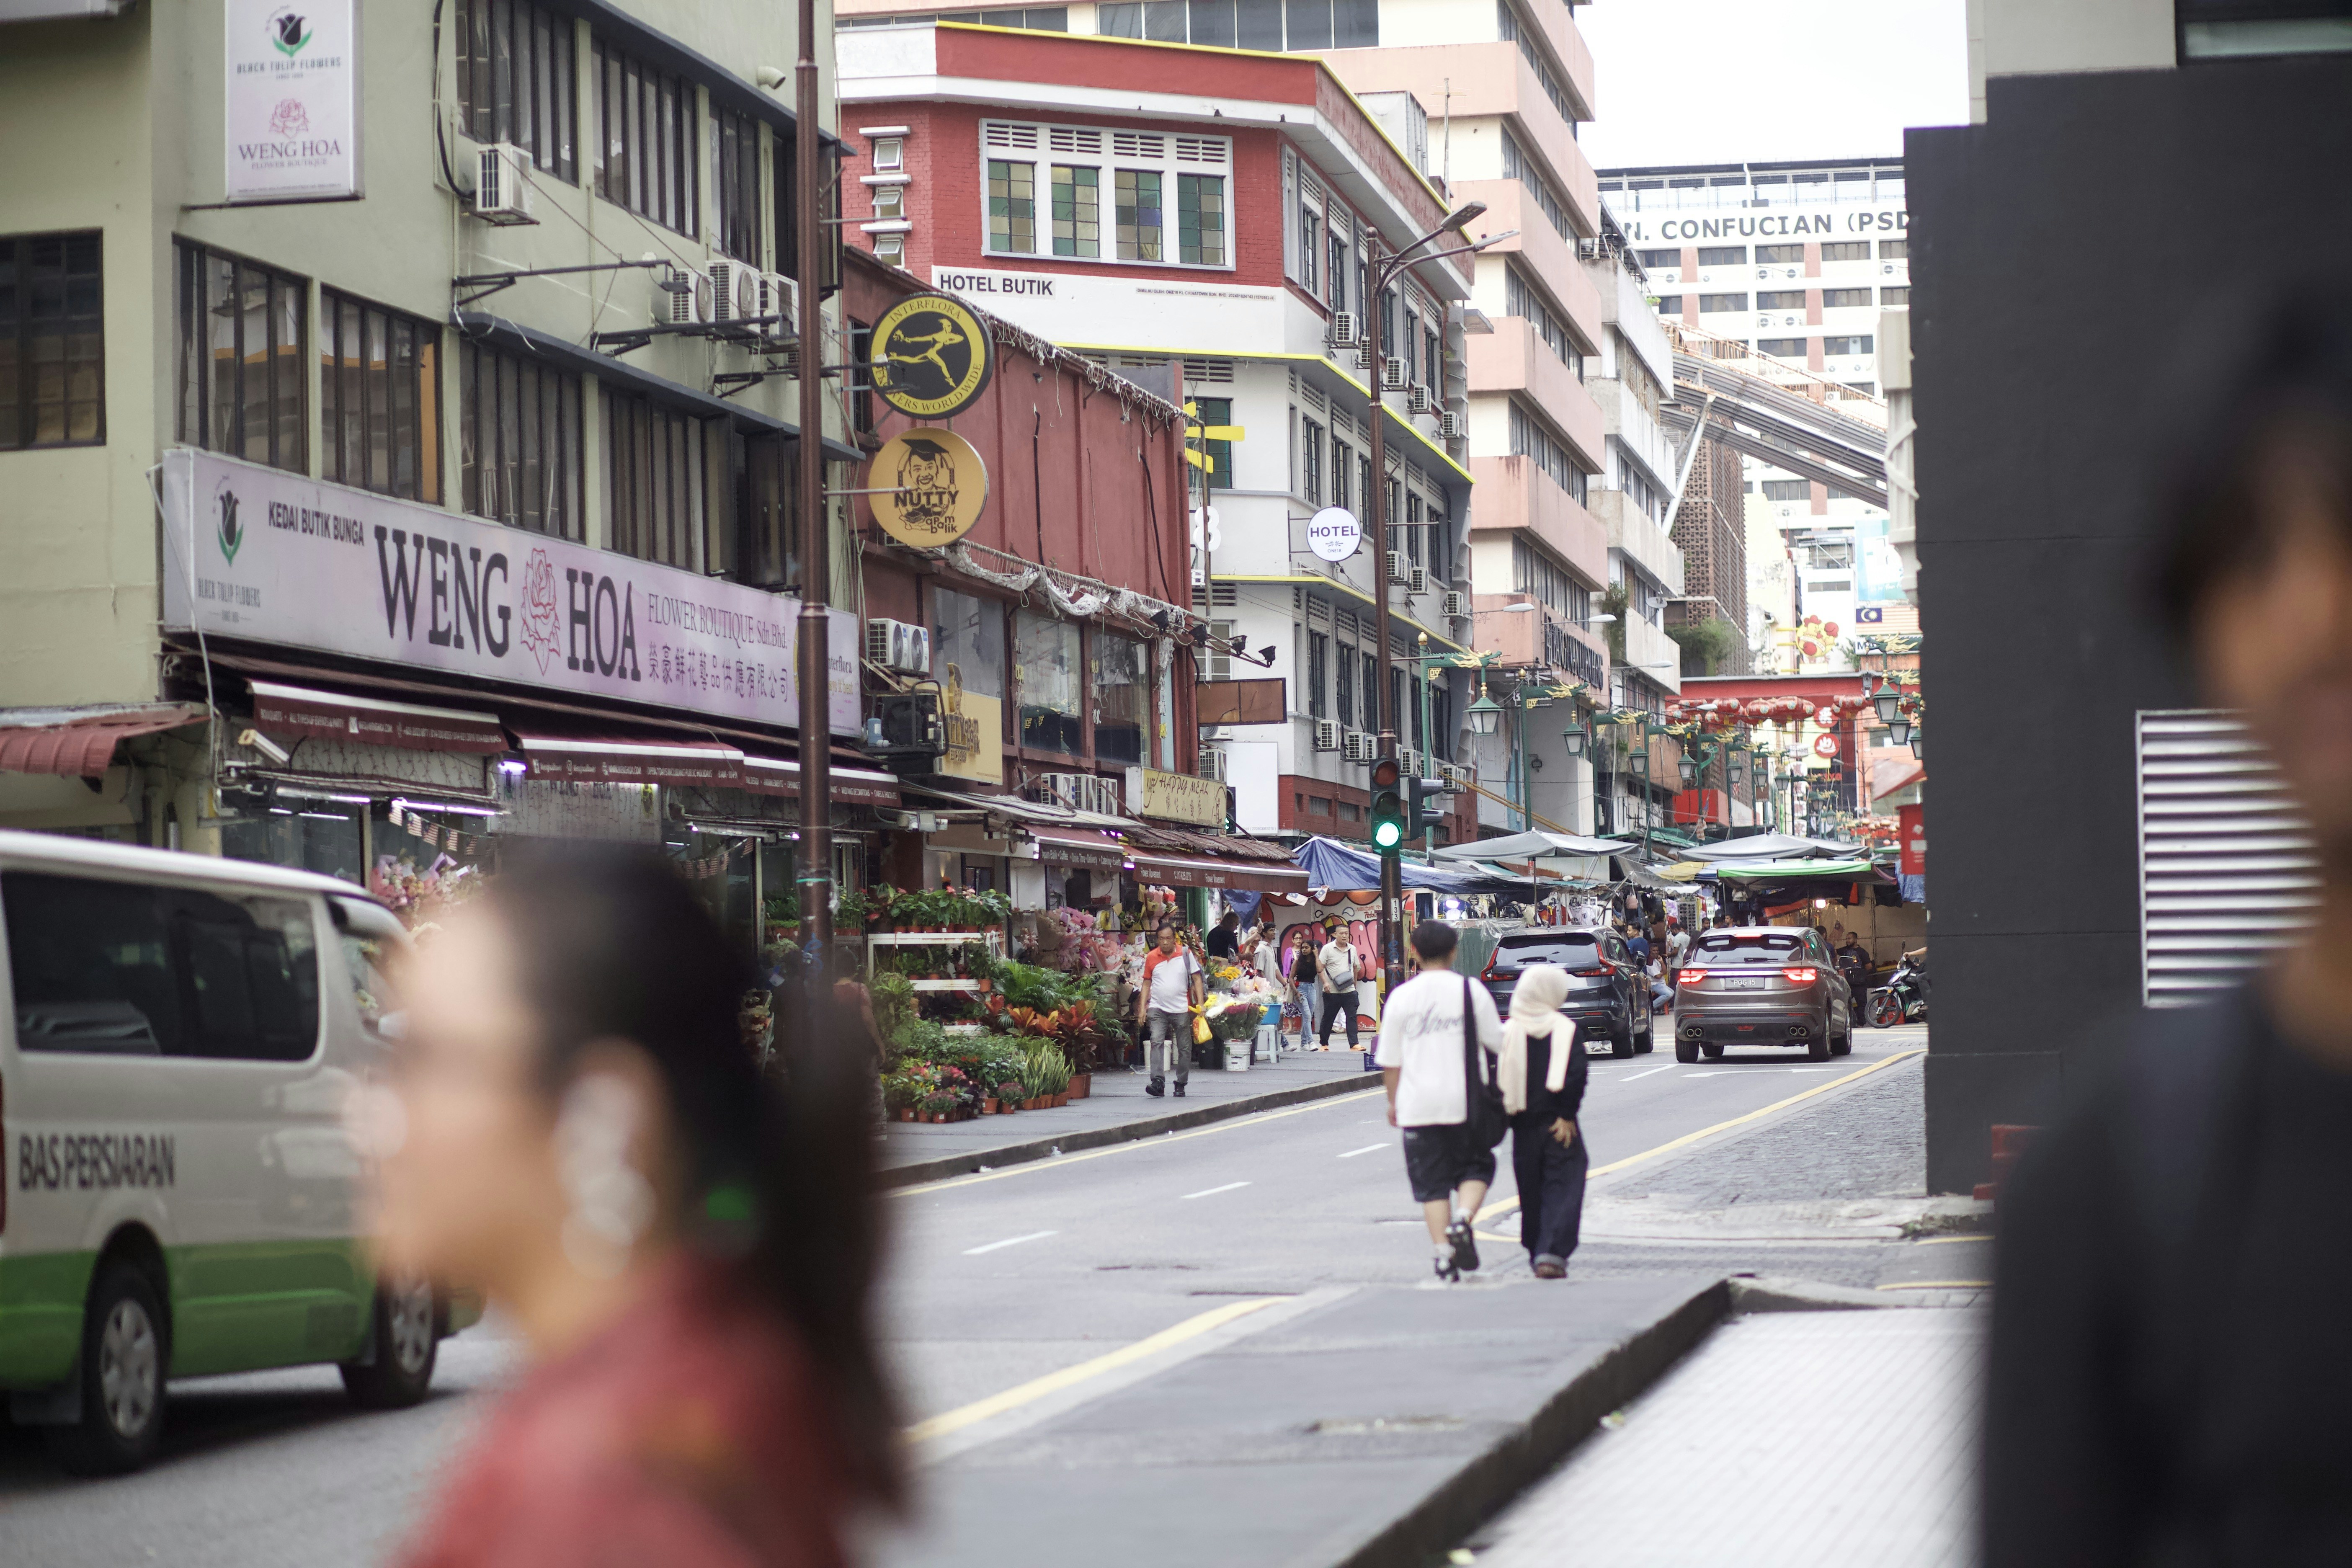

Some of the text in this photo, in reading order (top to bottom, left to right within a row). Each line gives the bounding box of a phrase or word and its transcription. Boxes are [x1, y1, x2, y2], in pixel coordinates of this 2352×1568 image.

[237, 57, 340, 74] BLACK TULIP FLOWERS
[238, 138, 341, 160] WENG HOA
[1661, 214, 1832, 240] CONFUCIAN
[941, 274, 1053, 295] HOTEL BUTIK
[890, 299, 961, 322] INTERFLORA
[921, 392, 963, 411] WORLD
[962, 363, 982, 392] WIDE
[894, 490, 959, 508] NUTTY
[268, 501, 364, 546] KEDAI BUTIK BUNGA
[1310, 526, 1358, 537] HOTEL
[374, 524, 641, 682] WENG HOA
[648, 593, 697, 632] FLOWER
[699, 605, 753, 649] BOUTIQUE
[828, 655, 852, 673] nterflora
[1159, 775, 1187, 795] HAPPY
[1189, 781, 1208, 798] MEAL
[19, 1132, 176, 1191] BAS PERSIARAN
